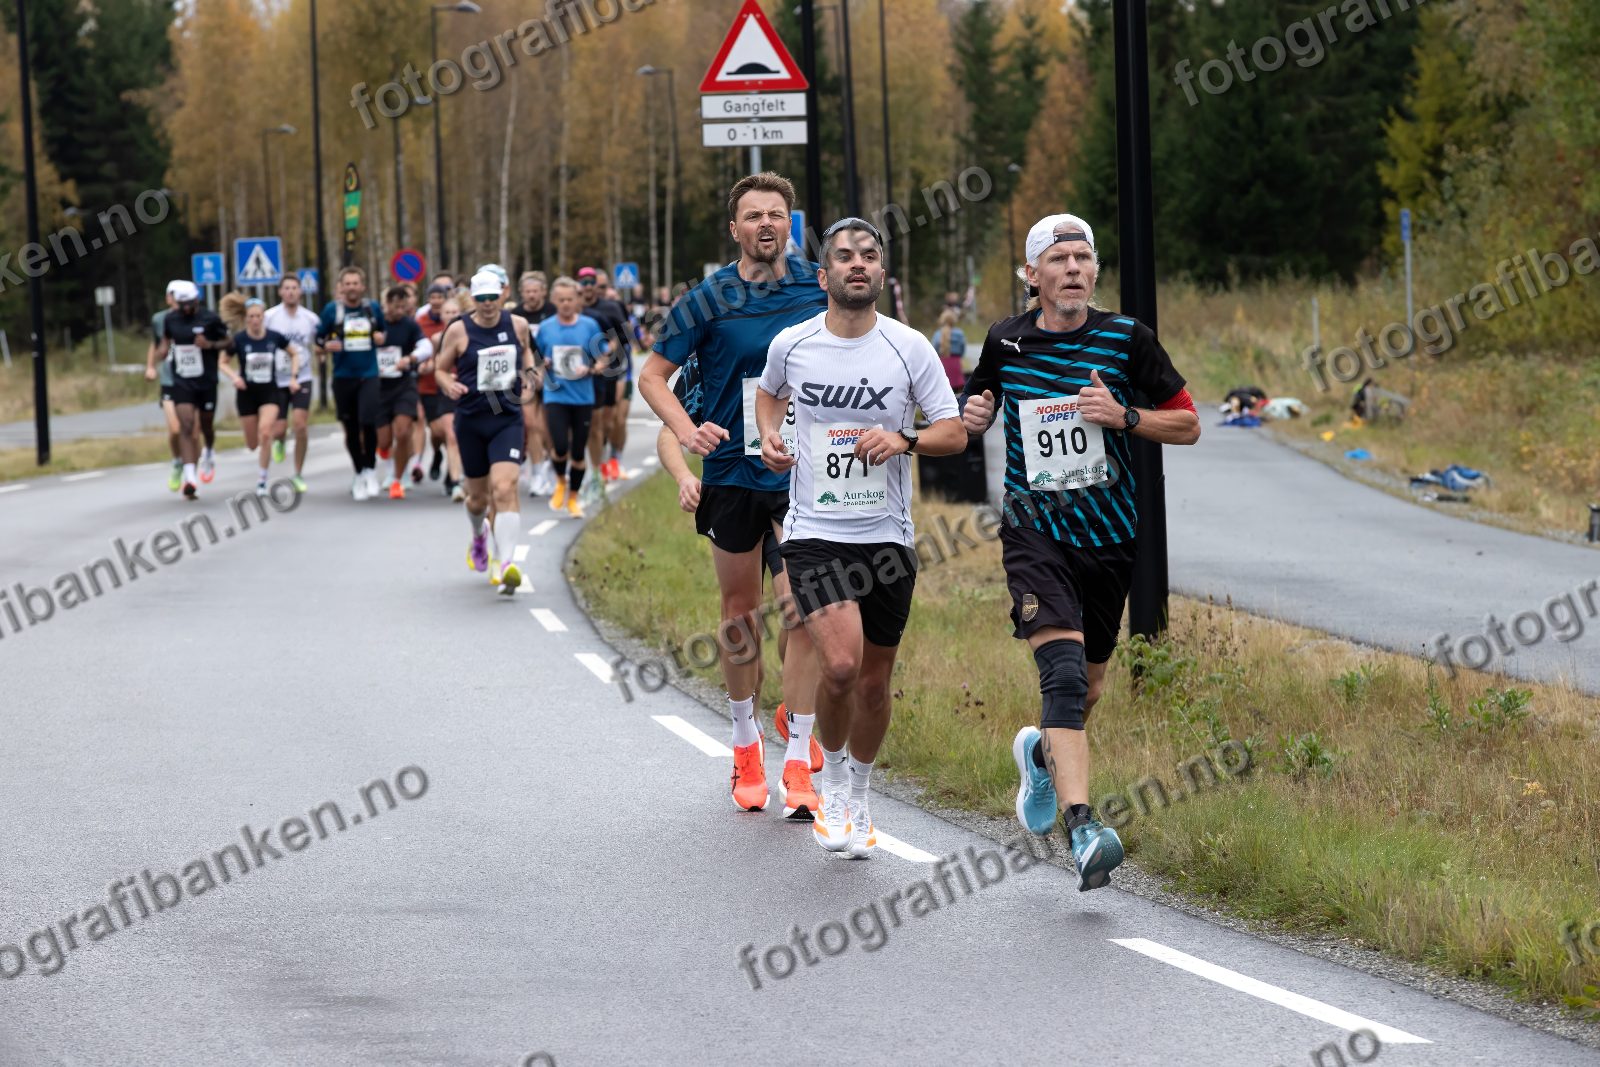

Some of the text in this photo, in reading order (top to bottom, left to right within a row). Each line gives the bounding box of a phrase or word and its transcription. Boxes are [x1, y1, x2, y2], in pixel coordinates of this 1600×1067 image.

[723, 99, 786, 115] Gangfelt
[727, 128, 738, 141] 0
[752, 127, 758, 140] 1
[762, 127, 784, 140] km
[485, 359, 508, 373] 408
[1041, 411, 1077, 424] LØPET
[828, 428, 870, 438] NORGE
[831, 436, 861, 446] LØPE
[1037, 426, 1088, 458] 910
[1060, 465, 1105, 479] Aurskog
[843, 489, 885, 501] Aurskog
